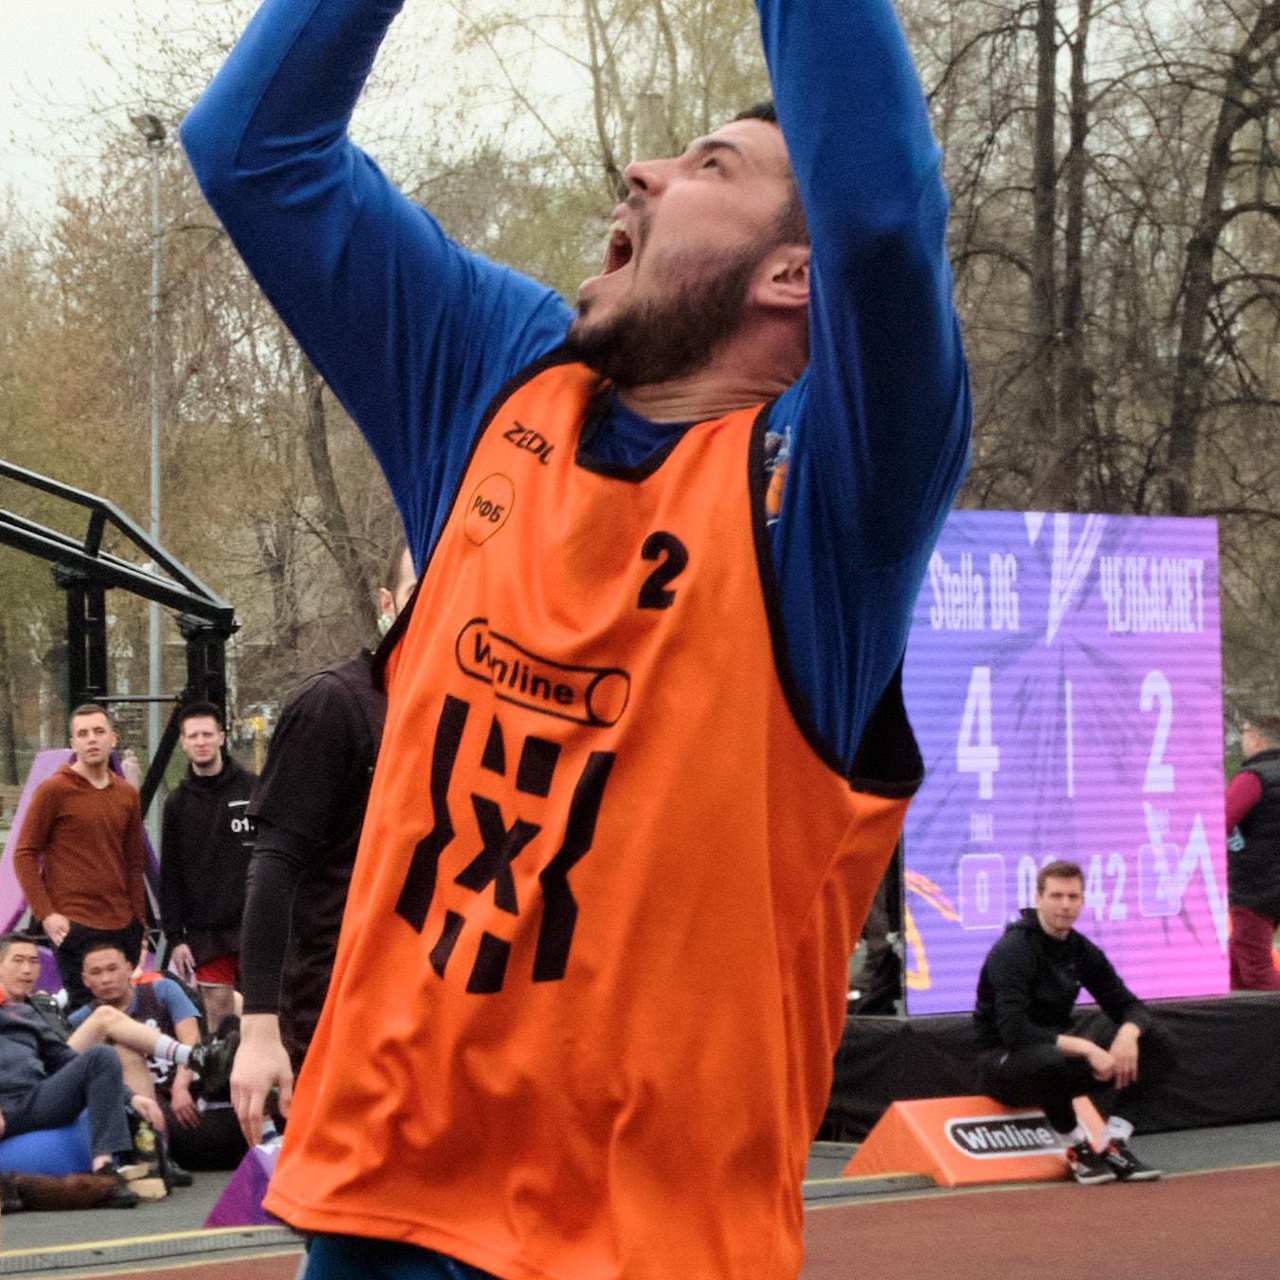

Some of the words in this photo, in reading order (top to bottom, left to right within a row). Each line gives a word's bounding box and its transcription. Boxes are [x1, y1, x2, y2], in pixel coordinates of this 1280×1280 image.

[637, 531, 689, 611] 2
[957, 666, 999, 800] 4
[1139, 670, 1174, 793] 2
[956, 1124, 1055, 1150] Winline
